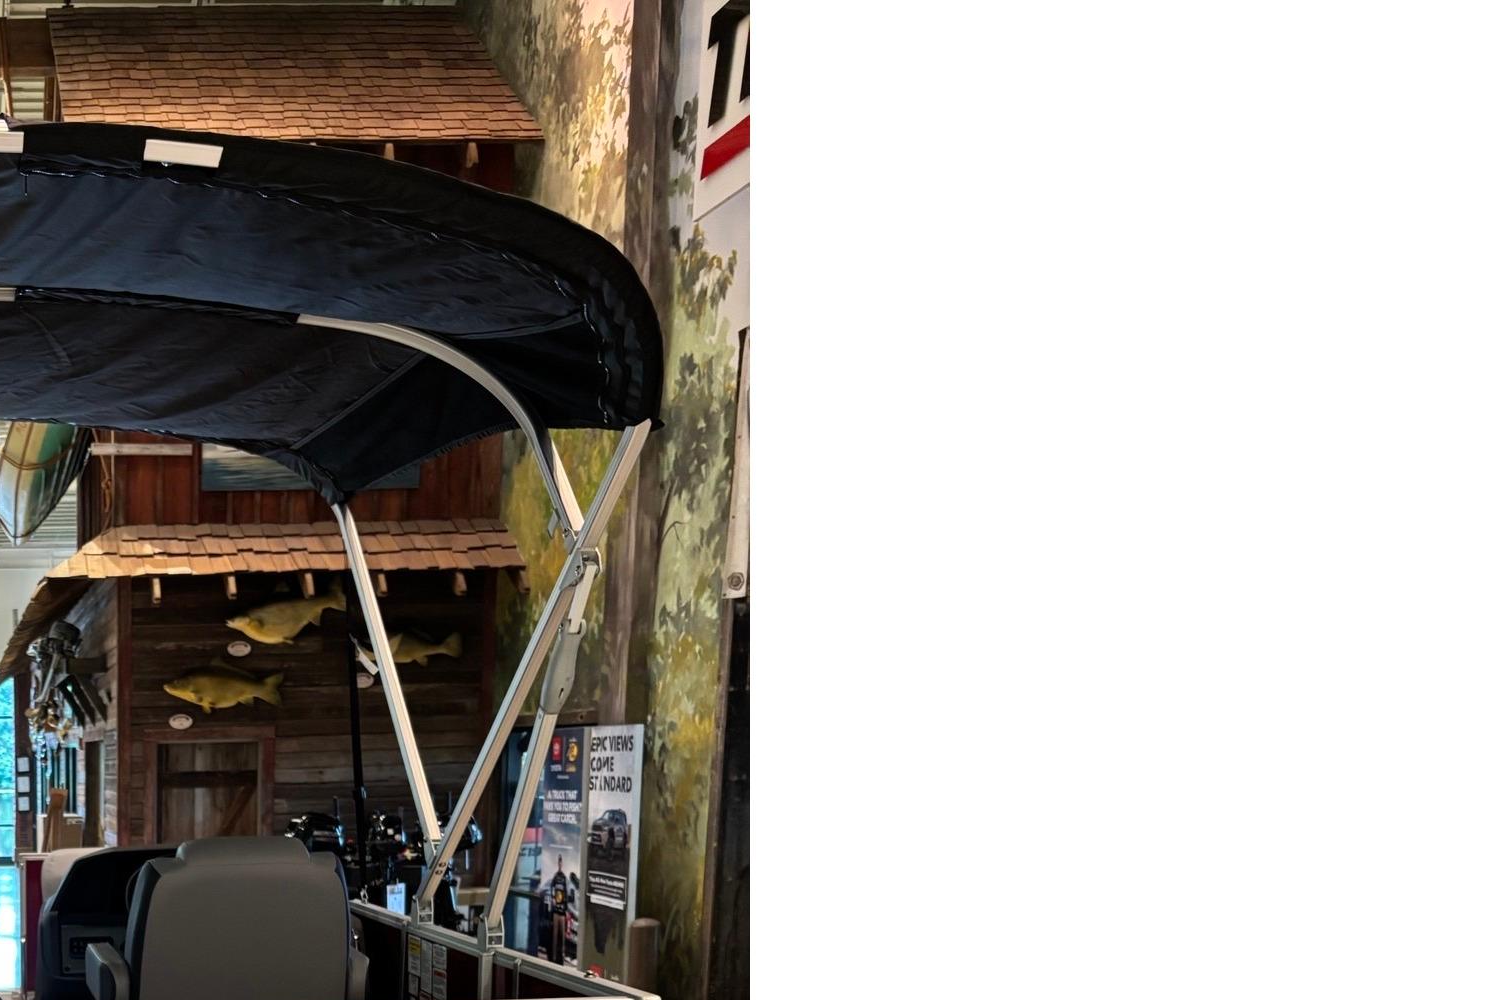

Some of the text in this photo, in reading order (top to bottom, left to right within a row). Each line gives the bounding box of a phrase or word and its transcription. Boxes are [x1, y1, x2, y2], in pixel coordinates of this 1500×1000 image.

[707, 0, 750, 128] T
[590, 735, 634, 752] EPIC VIEWS
[590, 756, 615, 772] COME
[588, 776, 632, 793] STANDARD
